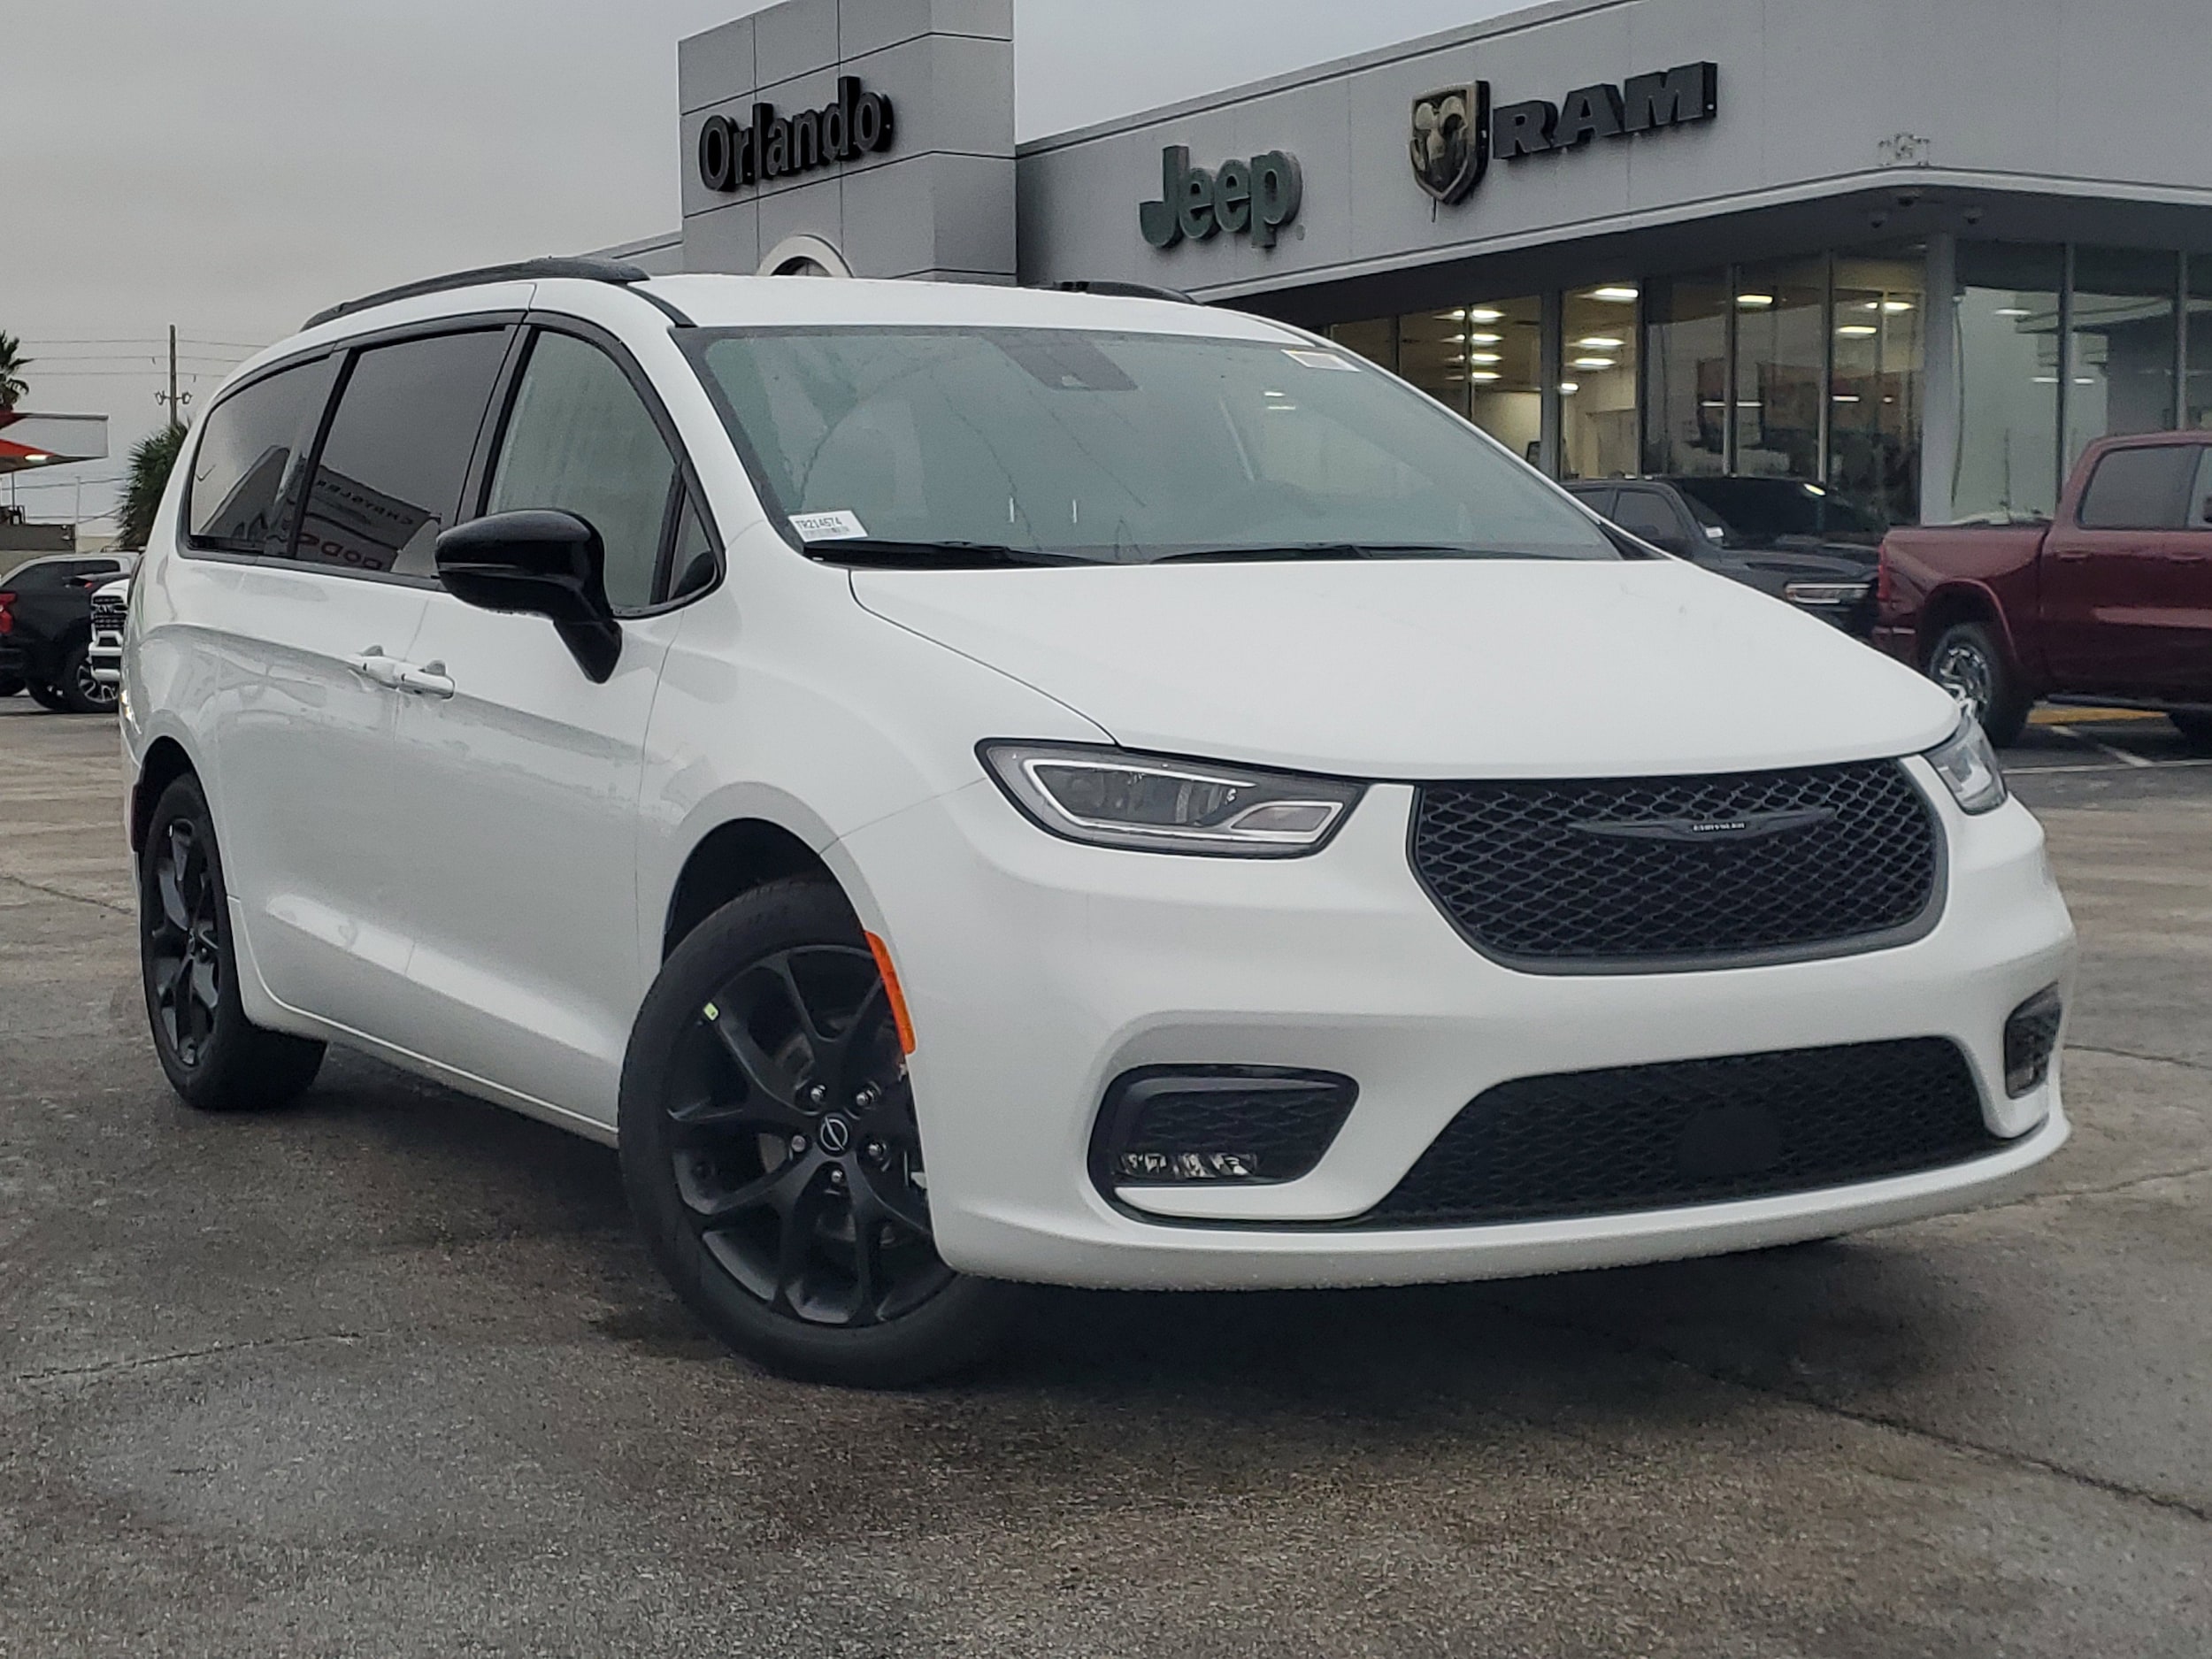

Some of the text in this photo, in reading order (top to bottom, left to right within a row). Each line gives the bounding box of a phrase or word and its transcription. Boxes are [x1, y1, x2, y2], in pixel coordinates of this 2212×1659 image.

[699, 76, 894, 193] Orlando
[1493, 61, 1718, 161] RAM
[1139, 145, 1302, 249] Jeep
